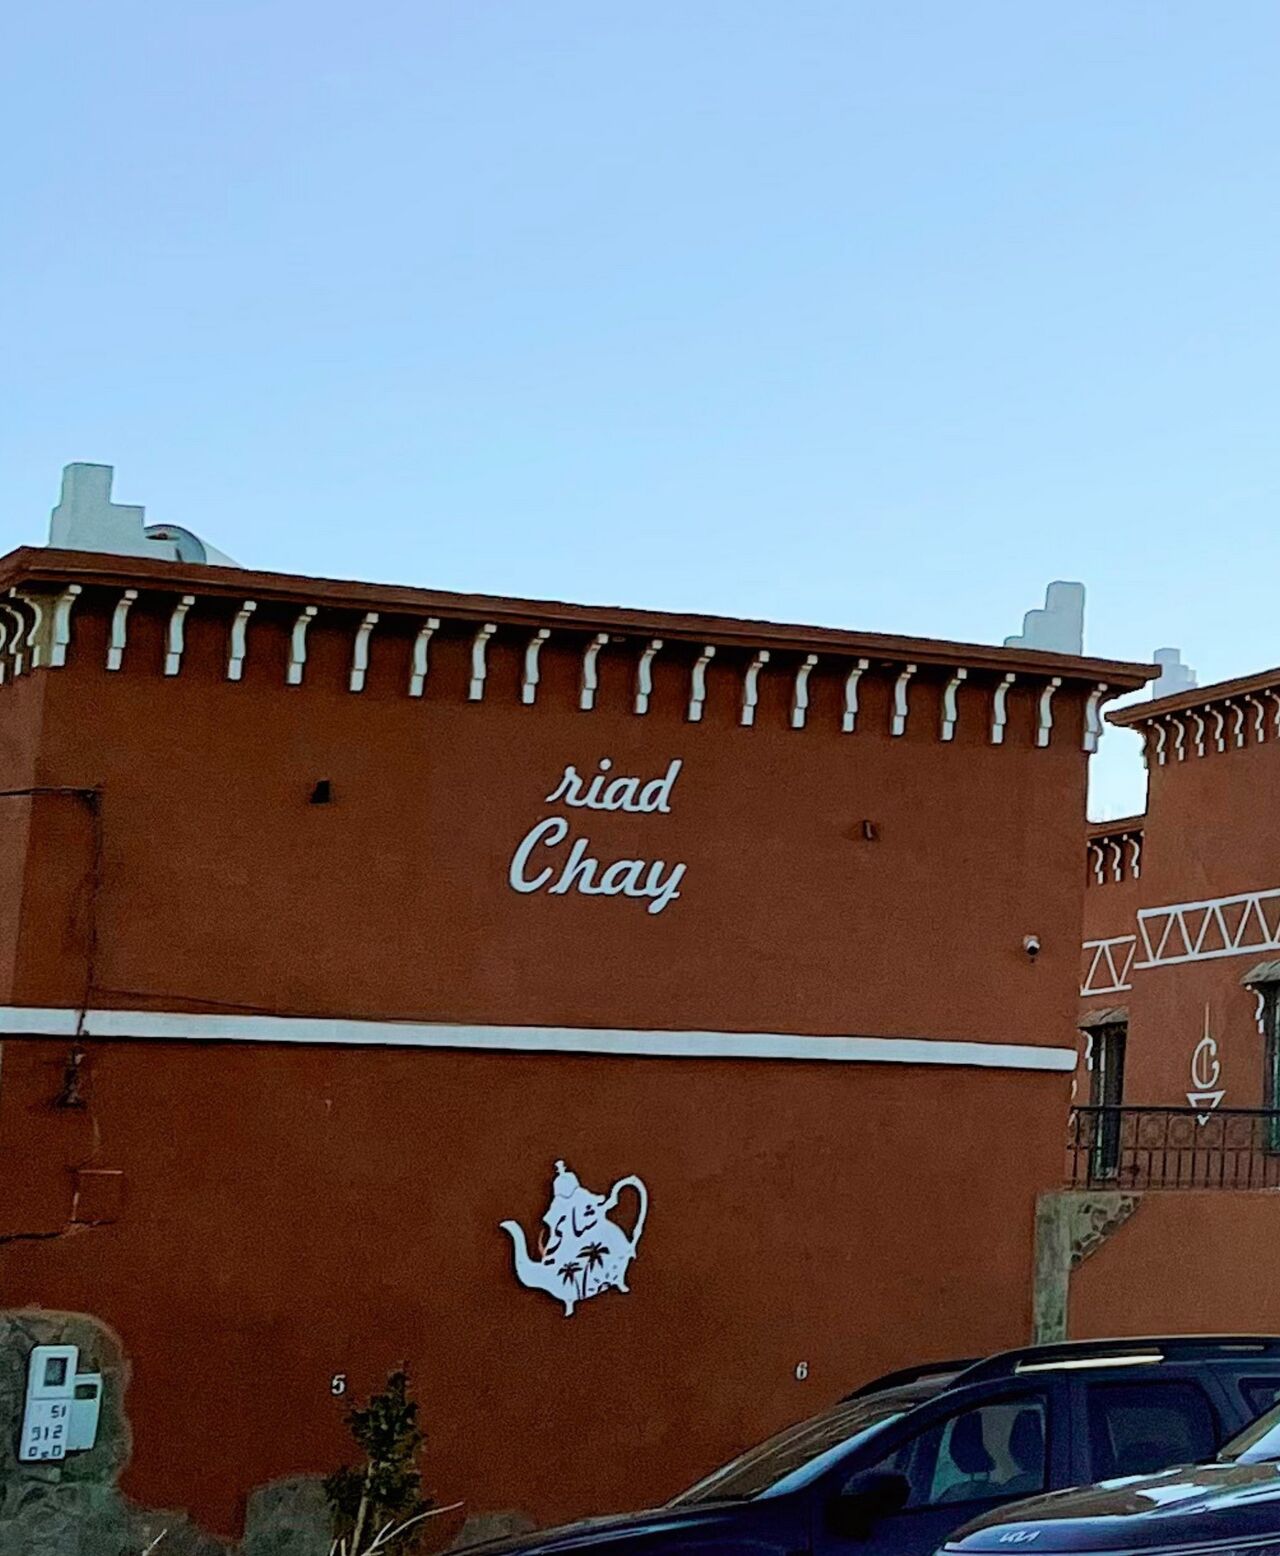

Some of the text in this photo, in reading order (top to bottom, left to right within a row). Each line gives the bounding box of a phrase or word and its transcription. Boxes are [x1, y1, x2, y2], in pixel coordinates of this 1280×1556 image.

[545, 758, 682, 813] riad
[510, 817, 687, 914] Chay
[544, 1205, 598, 1265] شاي
[331, 1374, 346, 1394] 5
[796, 1361, 808, 1380] 6
